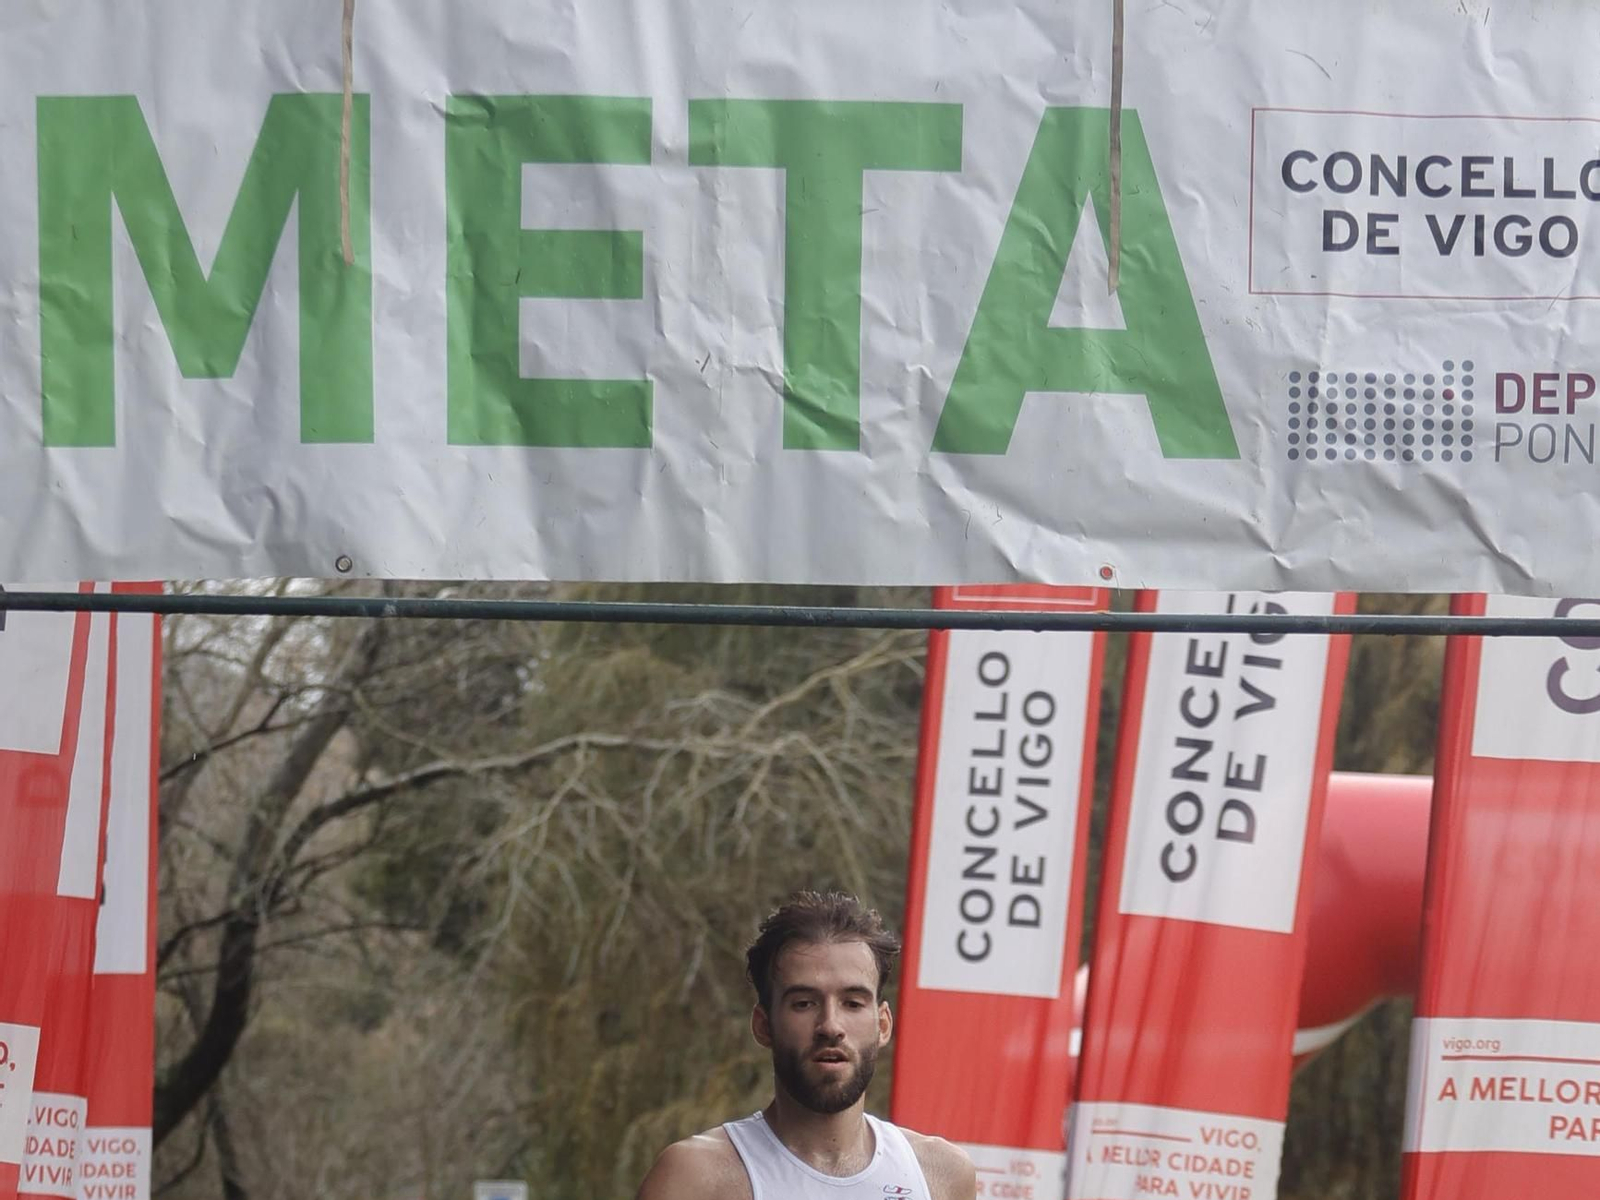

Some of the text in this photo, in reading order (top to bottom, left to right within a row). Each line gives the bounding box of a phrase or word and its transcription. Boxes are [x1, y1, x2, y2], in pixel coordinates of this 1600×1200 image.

[1322, 210, 1579, 258] DE VIGO
[36, 92, 1241, 459] META
[1495, 372, 1596, 415] DEP
[1494, 423, 1596, 464] PON
[956, 650, 1010, 963] CONCELLO
[1008, 690, 1057, 929] DE VIGO
[1216, 751, 1267, 844] DE
[1443, 1037, 1501, 1052] vigo.org
[1438, 1077, 1600, 1105] A MELLOR
[80, 1162, 136, 1179] IDADE
[1167, 1151, 1256, 1180] CIDADE
[83, 1184, 136, 1200] VIVIR
